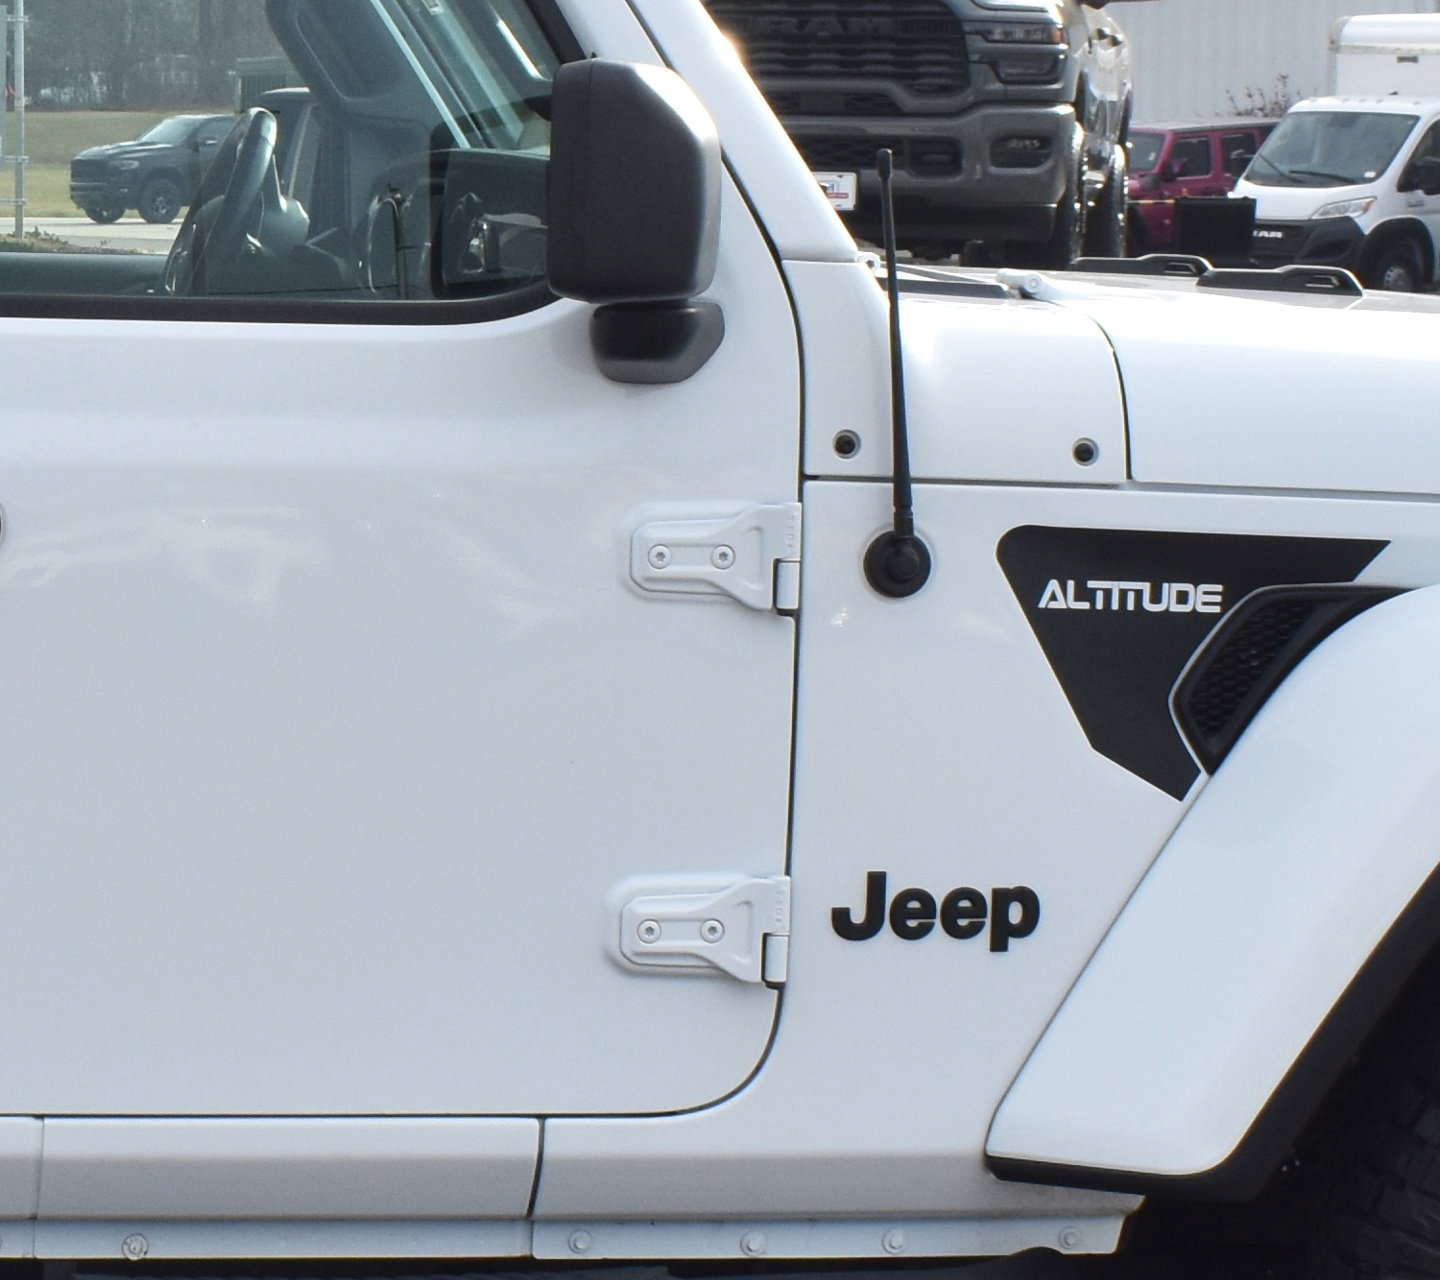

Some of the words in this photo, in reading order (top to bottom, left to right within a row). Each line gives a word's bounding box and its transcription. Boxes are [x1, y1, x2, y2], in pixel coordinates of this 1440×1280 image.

[1252, 230, 1283, 239] AM
[1037, 578, 1223, 613] ALTITUDE
[830, 870, 1041, 953] Jeep
